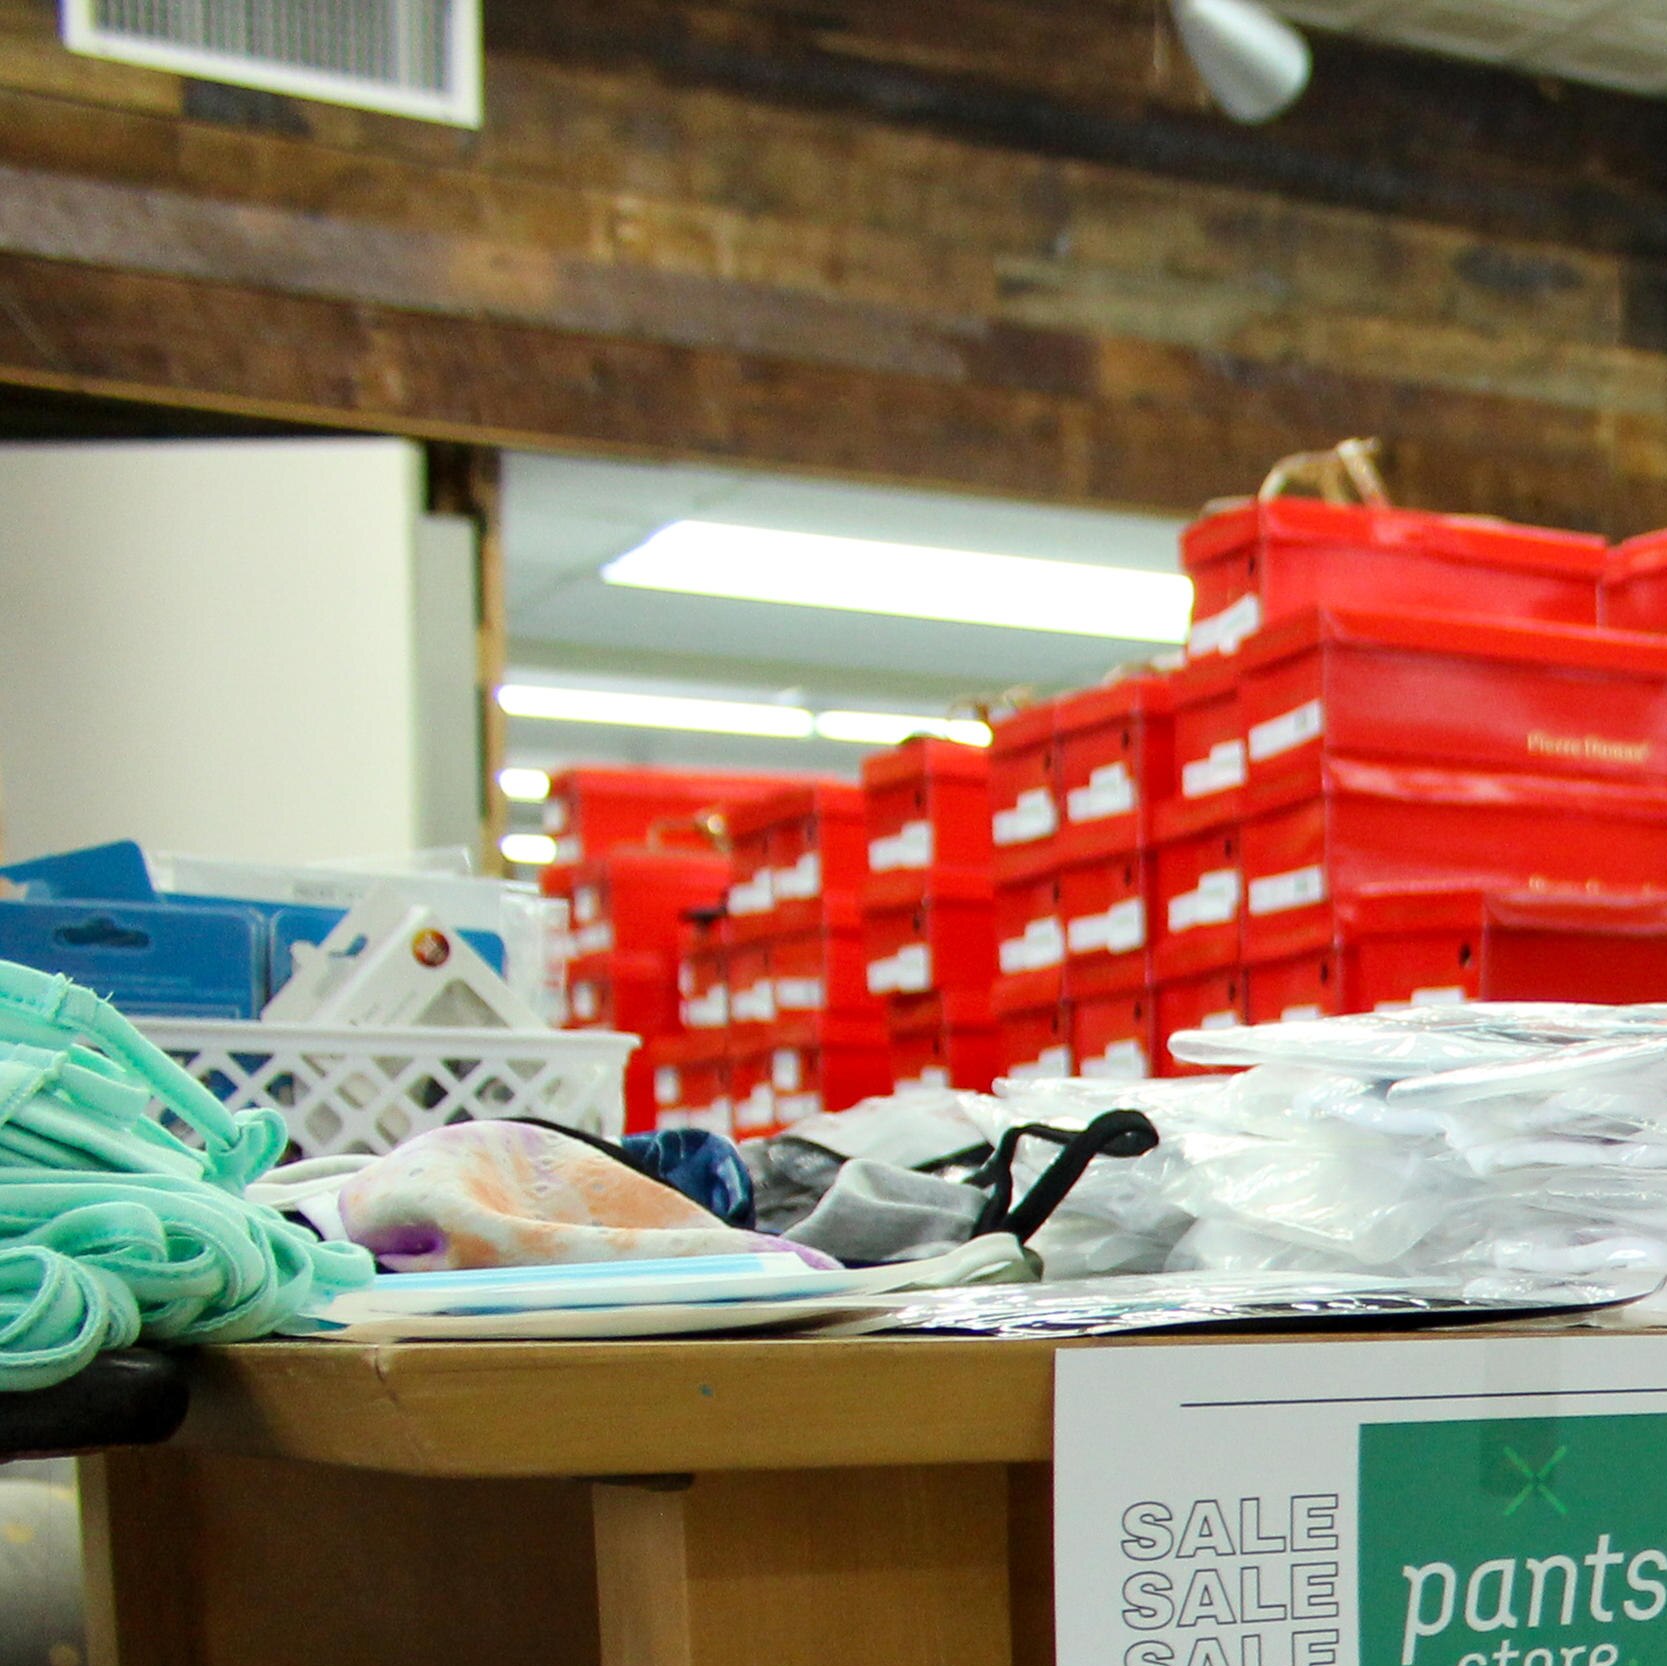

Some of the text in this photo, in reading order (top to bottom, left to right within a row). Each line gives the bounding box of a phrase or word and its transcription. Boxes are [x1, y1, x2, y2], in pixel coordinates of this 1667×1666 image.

[1123, 1494, 1340, 1560] SALE
[1123, 1562, 1340, 1629] SALE
[1403, 1534, 1667, 1665] pants
